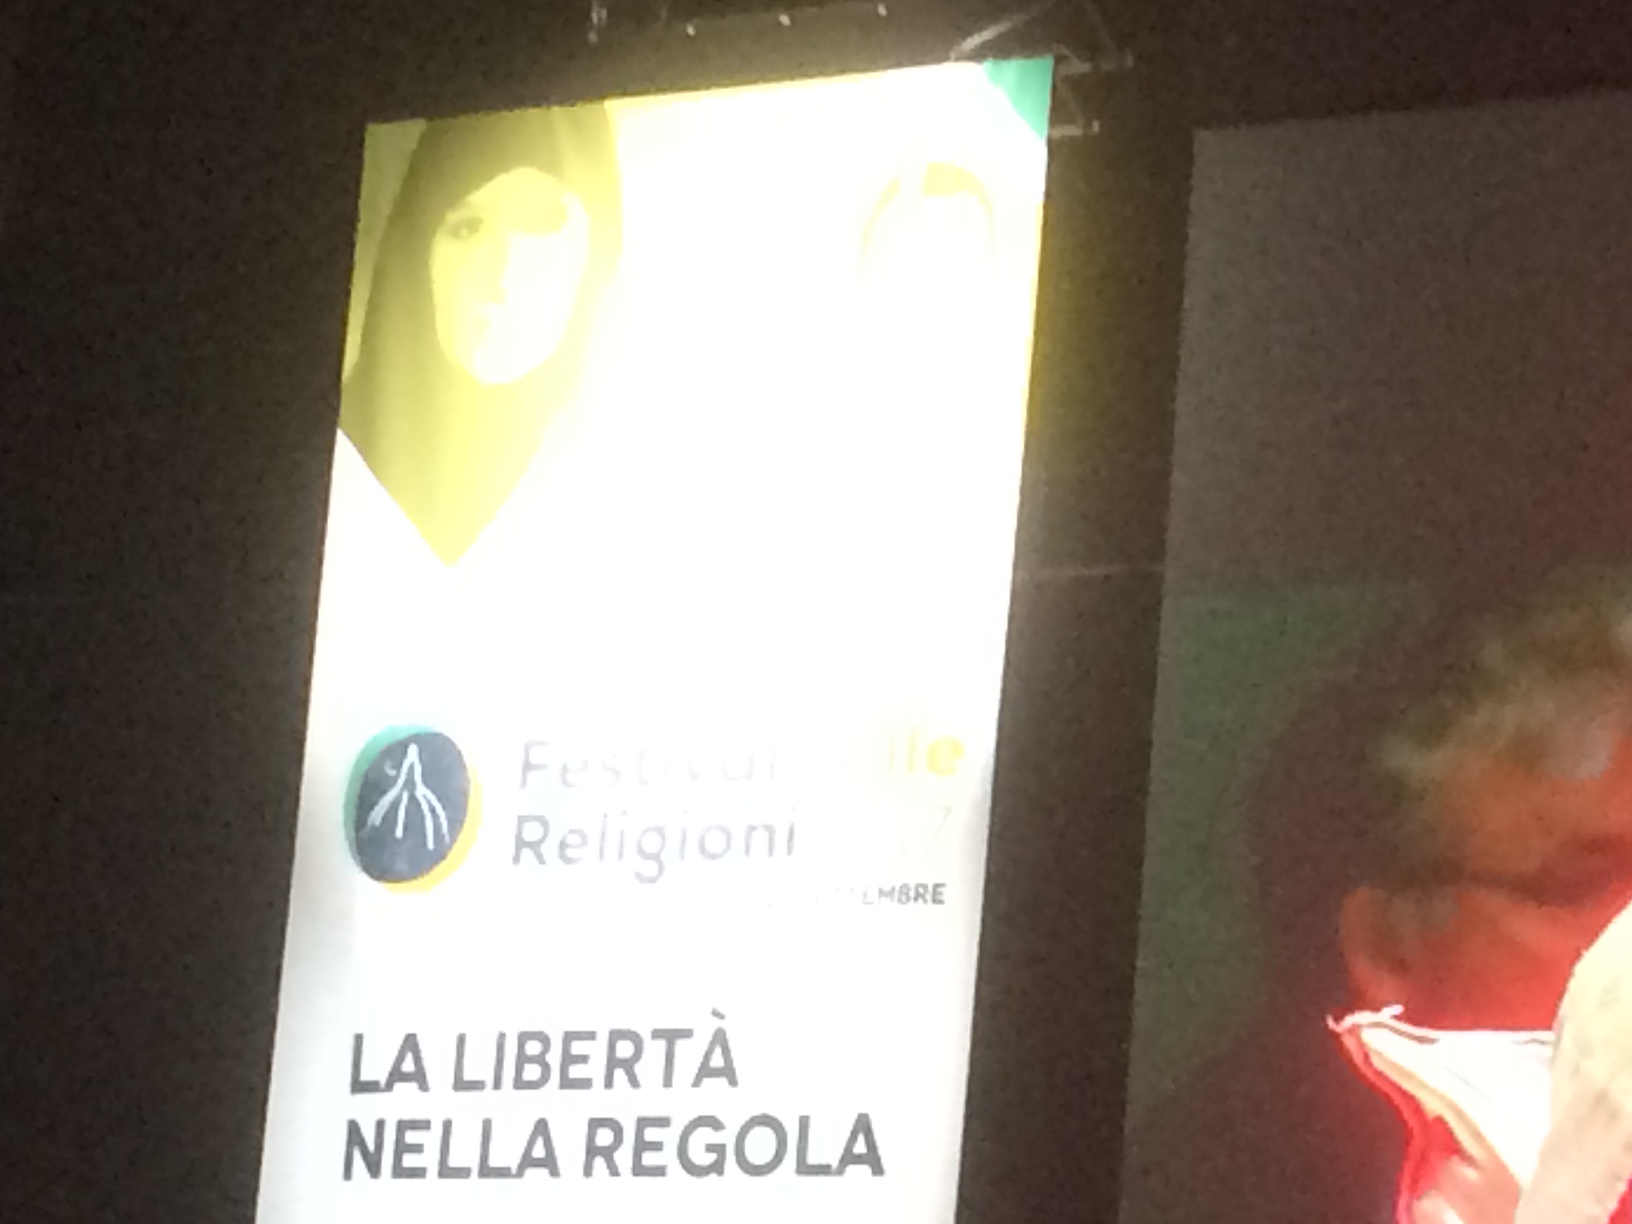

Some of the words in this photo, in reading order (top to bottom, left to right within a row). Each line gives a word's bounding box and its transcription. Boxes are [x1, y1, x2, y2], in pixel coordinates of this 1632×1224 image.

[511, 804, 797, 885] Religioni
[350, 1031, 430, 1094] LA
[451, 1008, 739, 1092] LIBERTÀ
[342, 1117, 561, 1181] NELLA
[582, 1113, 886, 1178] REGOLA
